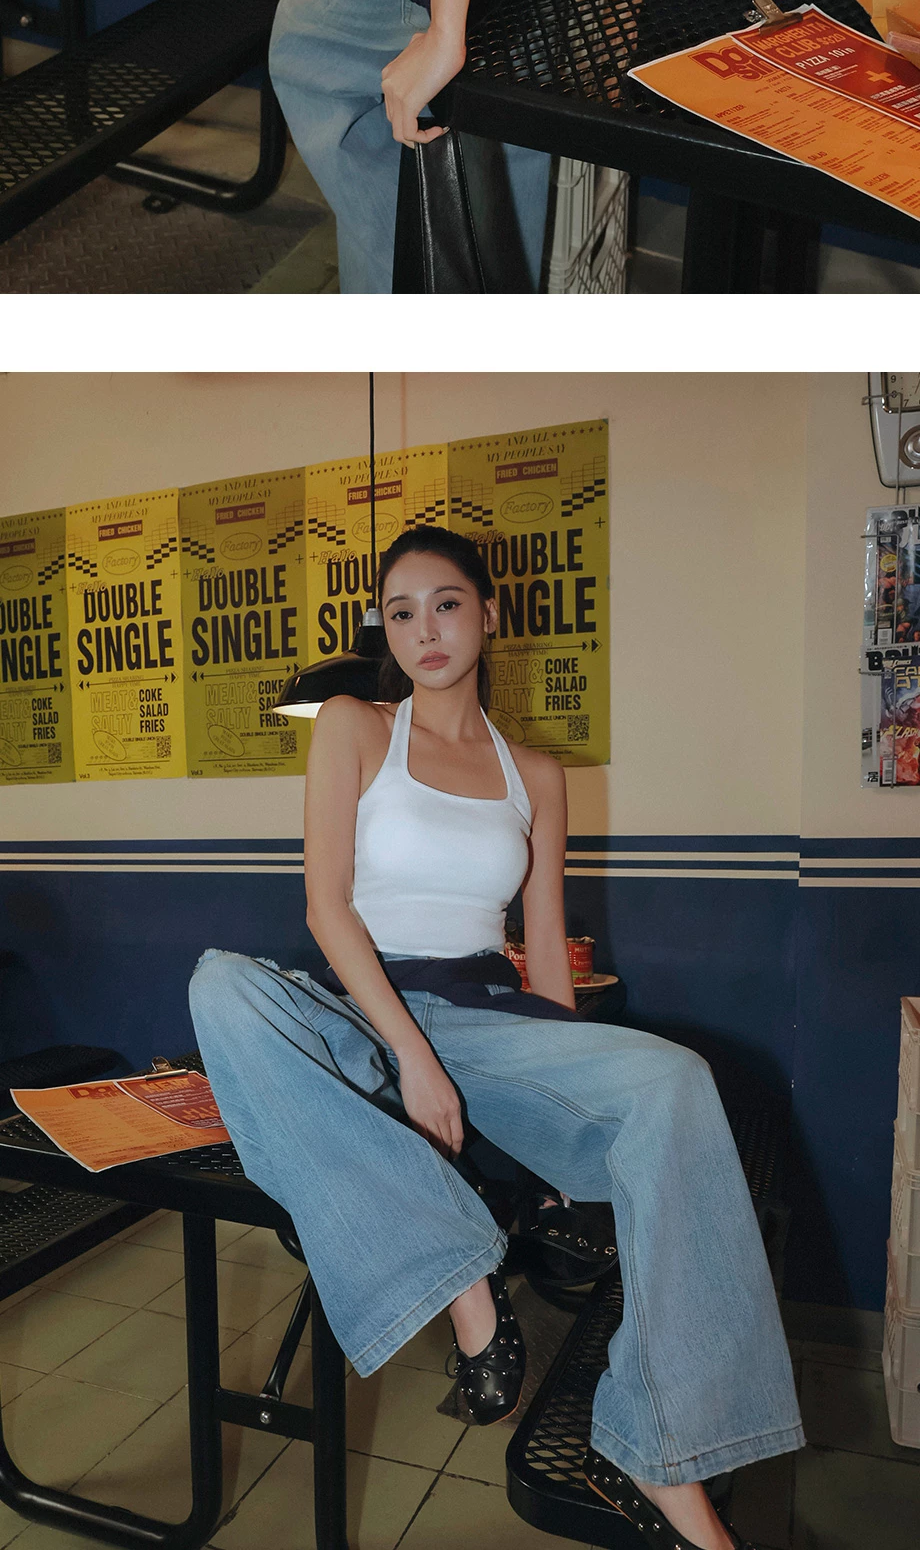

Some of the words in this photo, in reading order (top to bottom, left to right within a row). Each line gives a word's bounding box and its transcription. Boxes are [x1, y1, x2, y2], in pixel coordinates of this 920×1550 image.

[752, 21, 832, 50] MARGHERITA
[775, 39, 821, 58] CLUB
[817, 33, 846, 48] $320
[796, 55, 830, 70] PIZZA
[828, 47, 856, 59] 10in
[890, 375, 896, 383] 9
[904, 399, 909, 407] 7
[504, 446, 547, 460] PEOPLE
[497, 468, 518, 479] FRIED
[523, 463, 557, 475] CHICKEN
[348, 491, 368, 501] FRIED
[374, 484, 401, 497] HICKEN
[216, 511, 234, 520] FRIED
[237, 506, 264, 517] CHICKEN
[504, 500, 550, 515] Factory
[99, 529, 115, 537] FRIED
[118, 524, 142, 534] CHICKEN
[224, 540, 260, 553] Factory
[104, 554, 139, 569] Factory
[199, 565, 287, 612] DOUBLE
[83, 579, 162, 624] DOUBLE
[192, 607, 297, 666] SINGLE
[77, 620, 174, 675] SINGLE
[545, 658, 578, 674] COKE
[545, 676, 587, 693] SALAD
[90, 689, 139, 713] MEAT&
[139, 688, 162, 703] COKE
[205, 681, 257, 706] MEAT&
[32, 697, 53, 711] COKE
[140, 703, 169, 717] SALAD
[545, 694, 581, 711] FRIES
[32, 712, 59, 725] SALAD
[91, 713, 132, 735] SALTY
[140, 719, 165, 733] FRIES
[206, 707, 251, 729] SALTY
[260, 713, 289, 728] FRIES
[33, 727, 56, 740] FRIES
